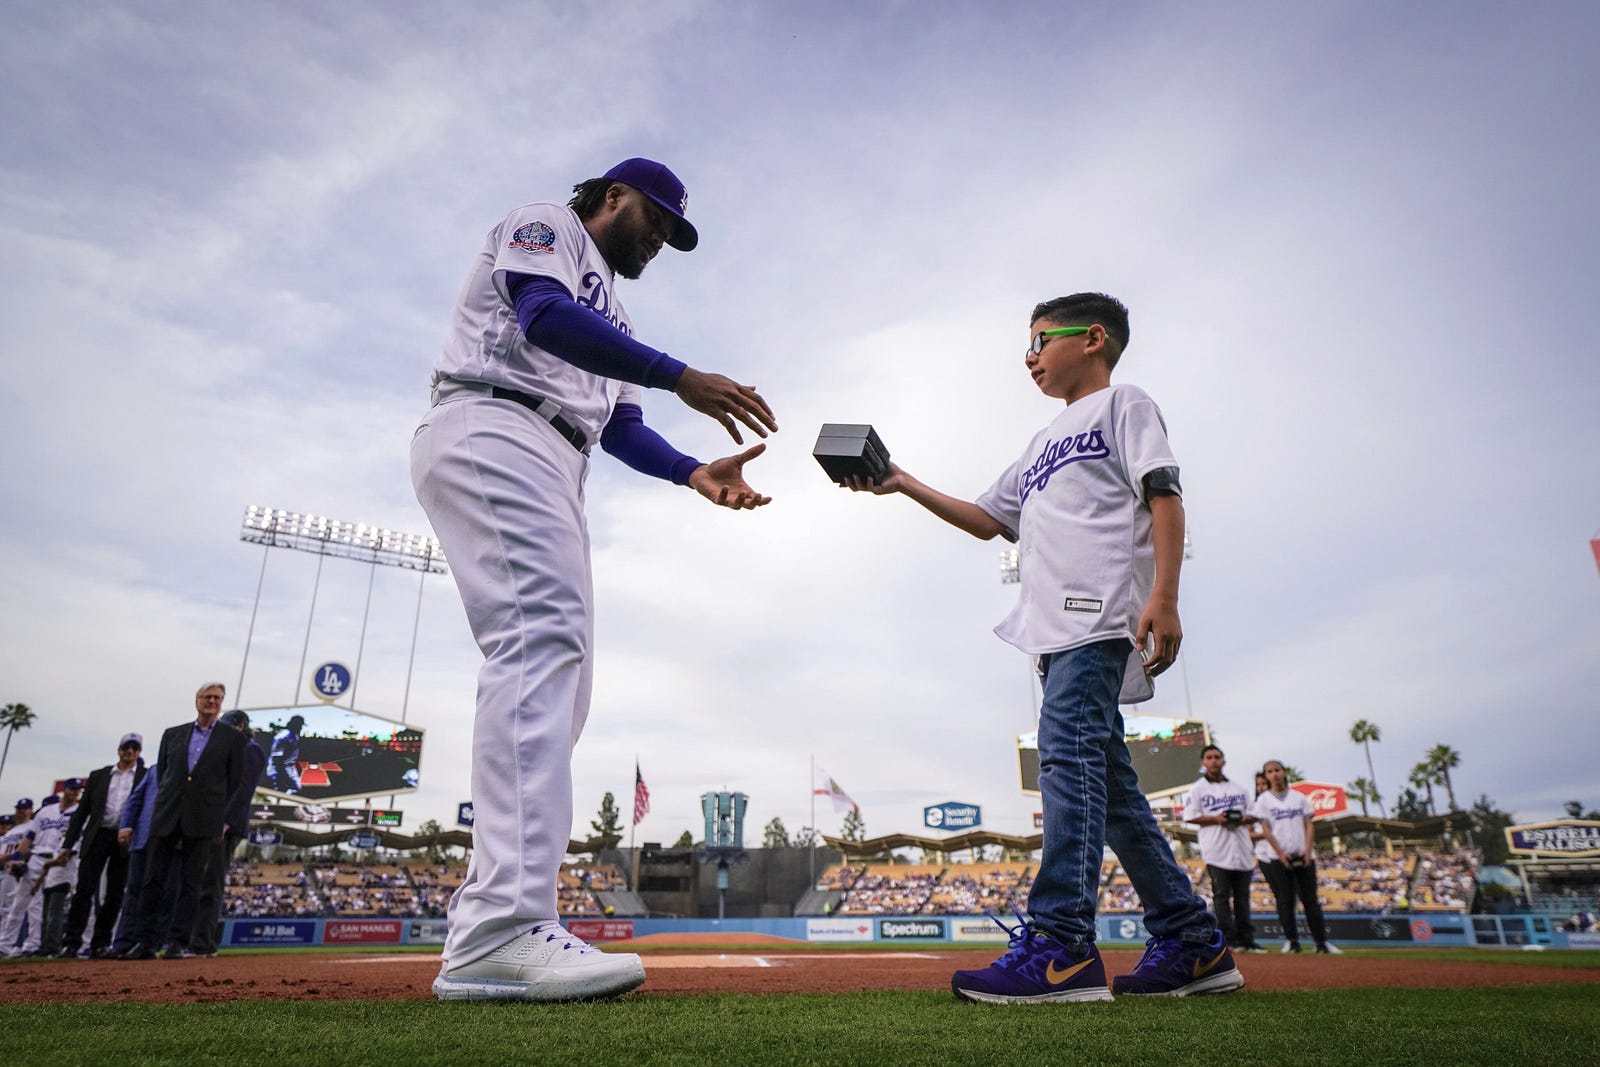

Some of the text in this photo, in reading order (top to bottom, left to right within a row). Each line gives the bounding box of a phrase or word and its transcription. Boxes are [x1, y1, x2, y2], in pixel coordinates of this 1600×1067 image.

[321, 665, 342, 693] LA
[944, 806, 977, 818] Security
[881, 922, 939, 938] Spectrum
